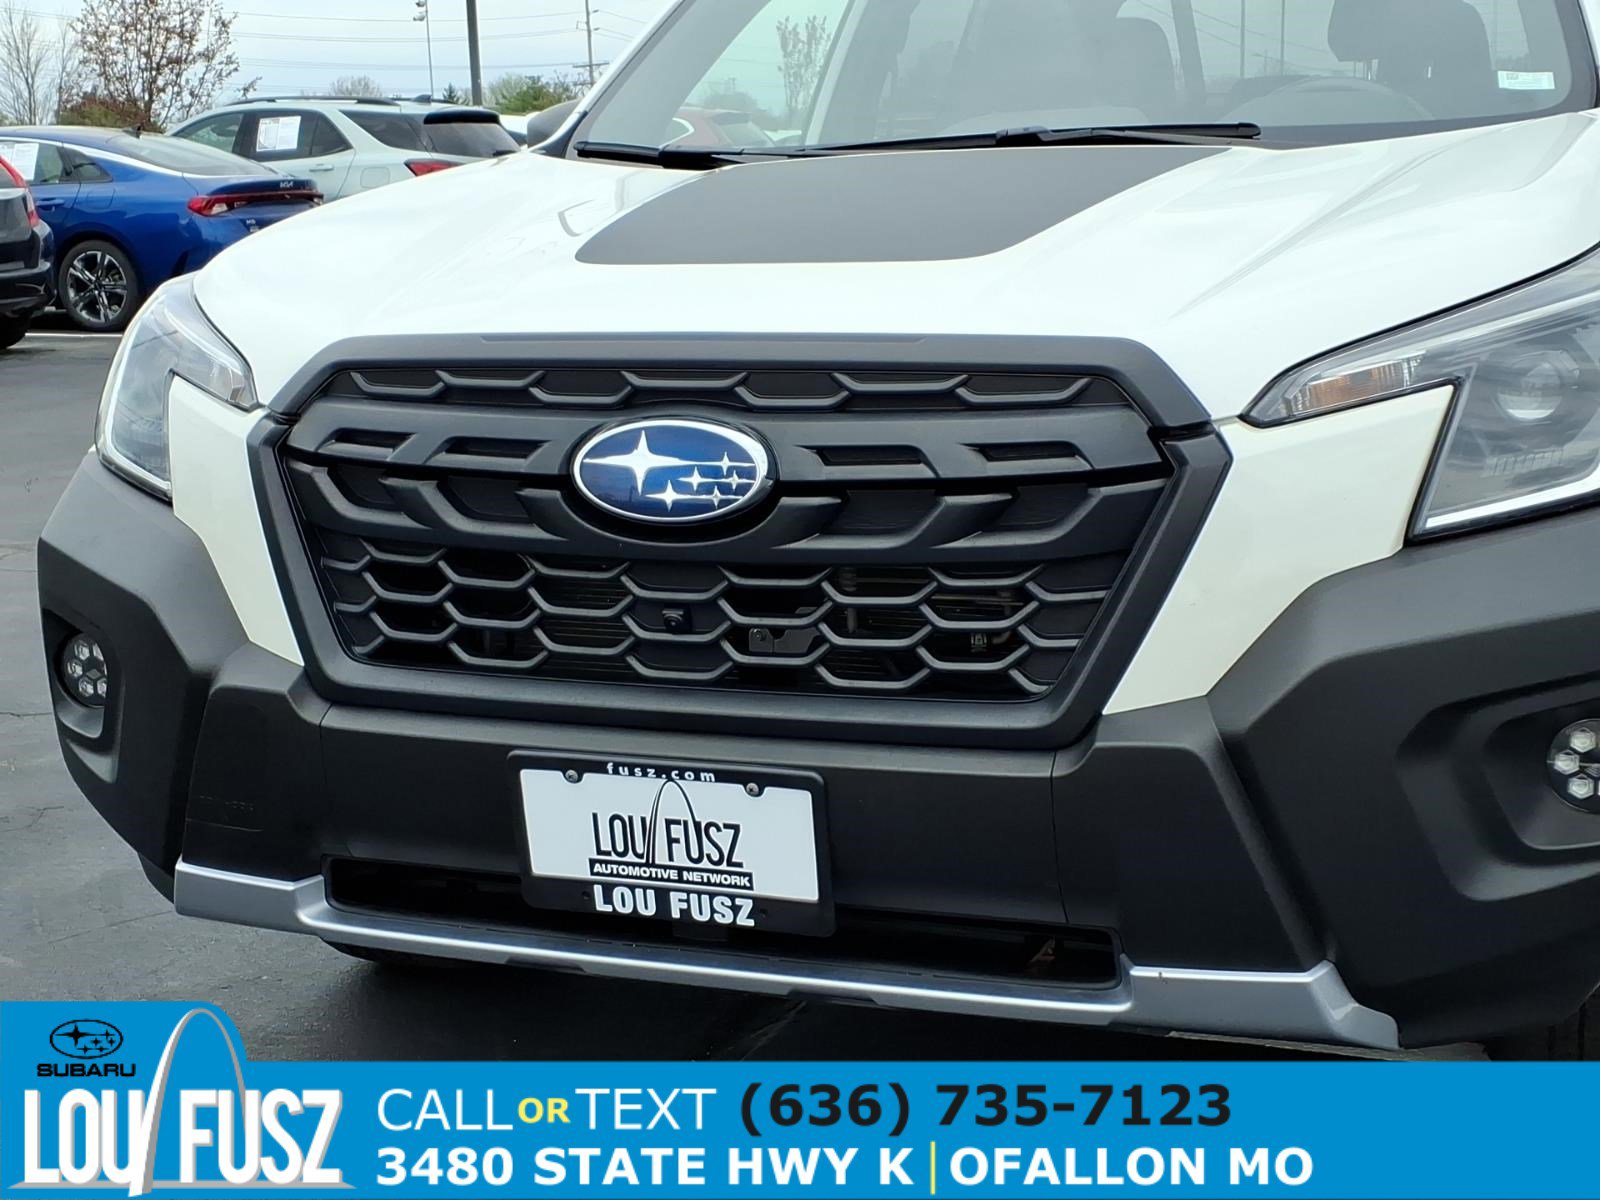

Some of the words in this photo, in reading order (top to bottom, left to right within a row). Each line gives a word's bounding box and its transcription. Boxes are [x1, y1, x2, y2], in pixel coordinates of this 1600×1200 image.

[606, 762, 716, 782] fusz.com
[592, 812, 648, 860] LOU
[665, 817, 744, 869] FUSZ
[593, 863, 679, 881] AUTOMOTIVE
[683, 870, 750, 888] NETWORK
[593, 884, 656, 917] LOU
[670, 891, 755, 928] FUSZ
